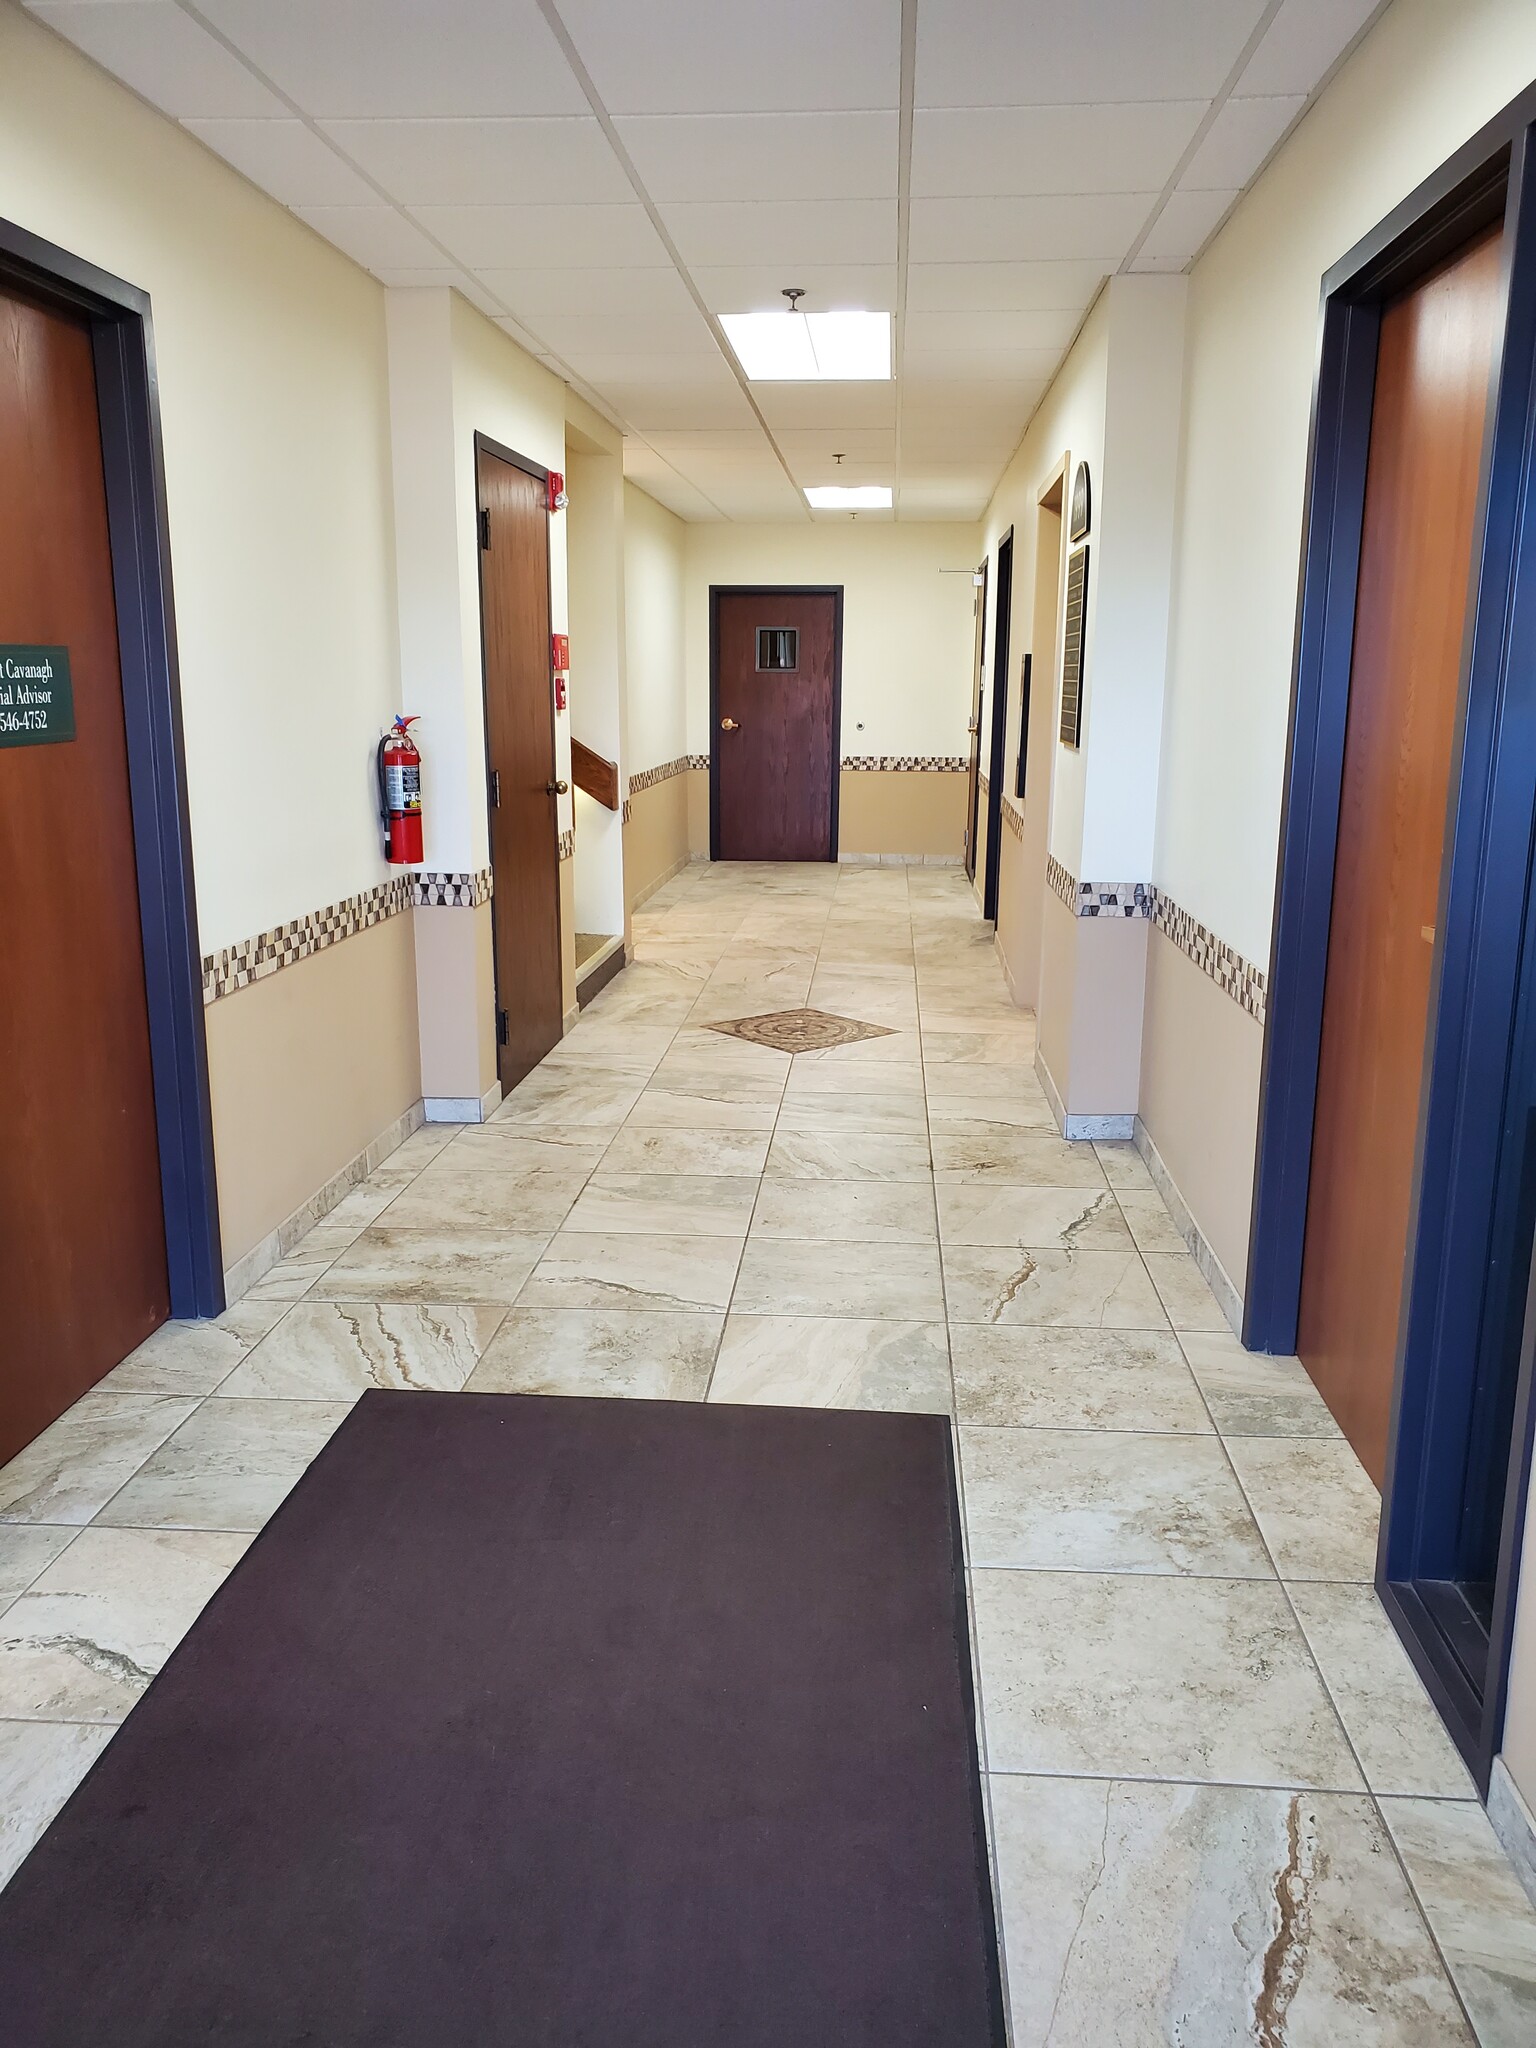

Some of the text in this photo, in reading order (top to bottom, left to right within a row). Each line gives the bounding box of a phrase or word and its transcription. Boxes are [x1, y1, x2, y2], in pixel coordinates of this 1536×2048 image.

[6, 658, 53, 683] Cavanagh
[16, 684, 52, 704] Advisor
[0, 710, 48, 732] 546-4752
